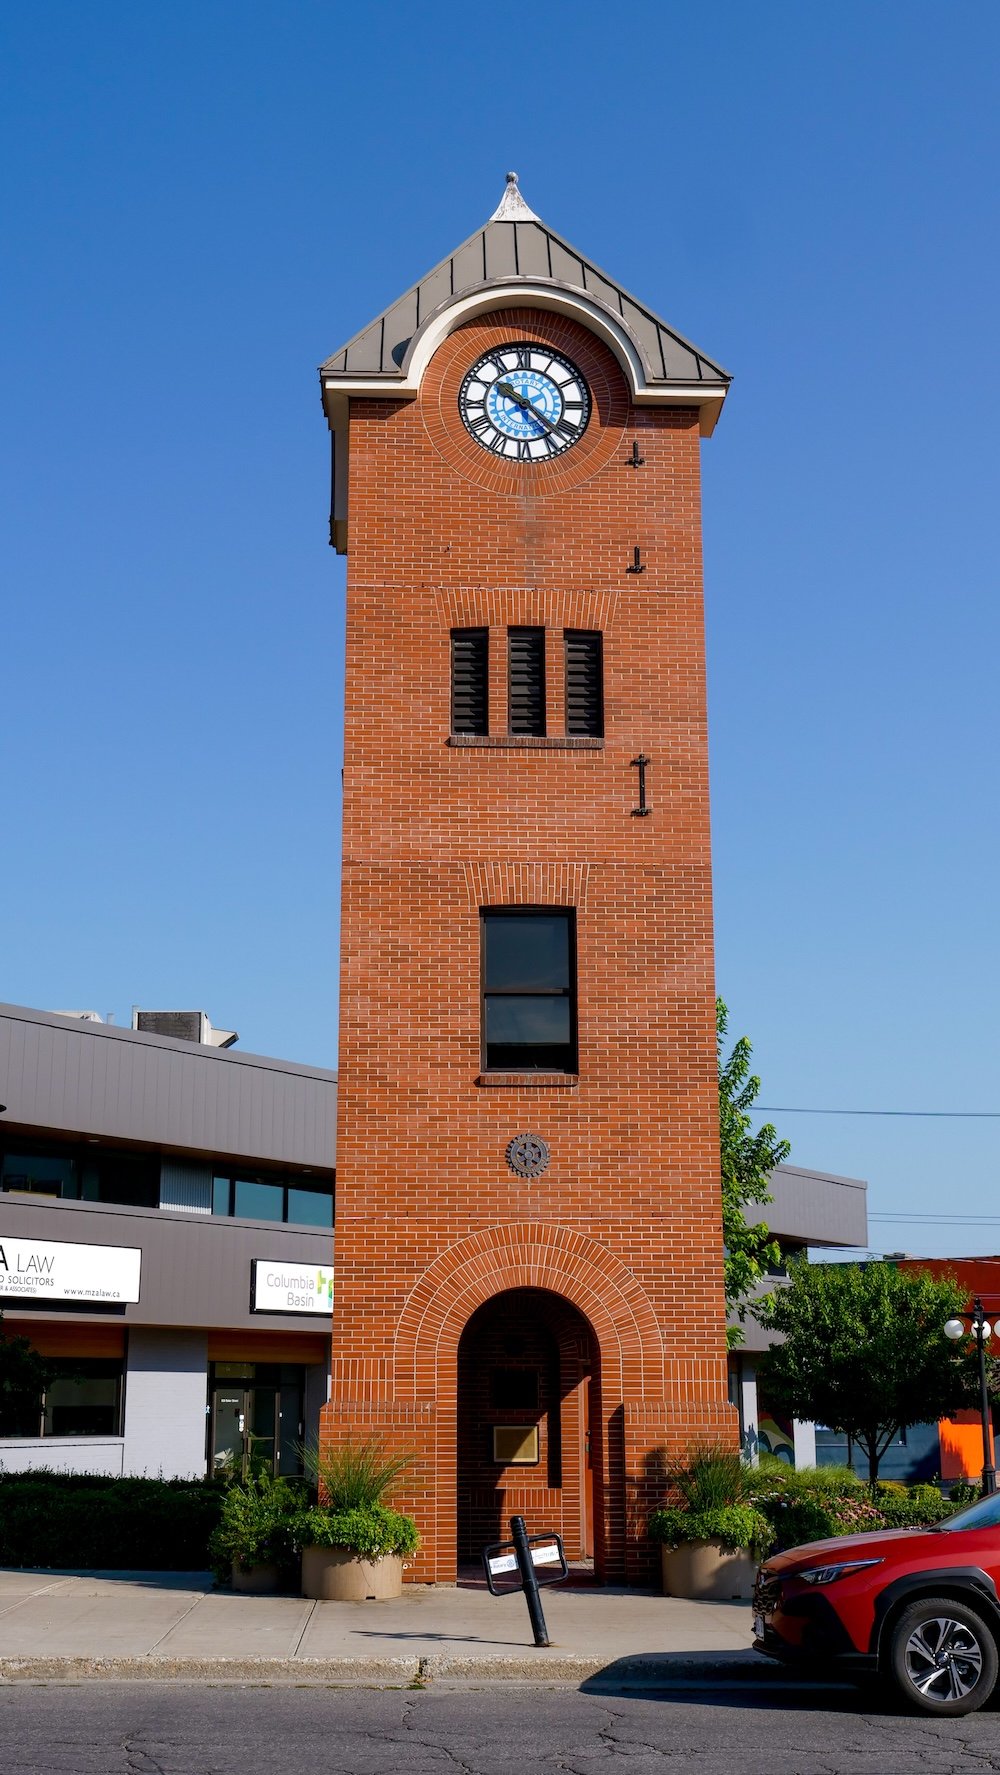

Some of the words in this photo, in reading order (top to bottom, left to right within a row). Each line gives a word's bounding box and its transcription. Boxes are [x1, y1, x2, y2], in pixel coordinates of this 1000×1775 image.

[510, 378, 539, 388] ROTARY
[17, 1253, 55, 1274] LAW
[8, 1275, 55, 1287] SOLICITORS
[266, 1273, 315, 1290] Columbia
[63, 1288, 120, 1298] www.mzalaw.ca
[287, 1291, 315, 1307] Basin
